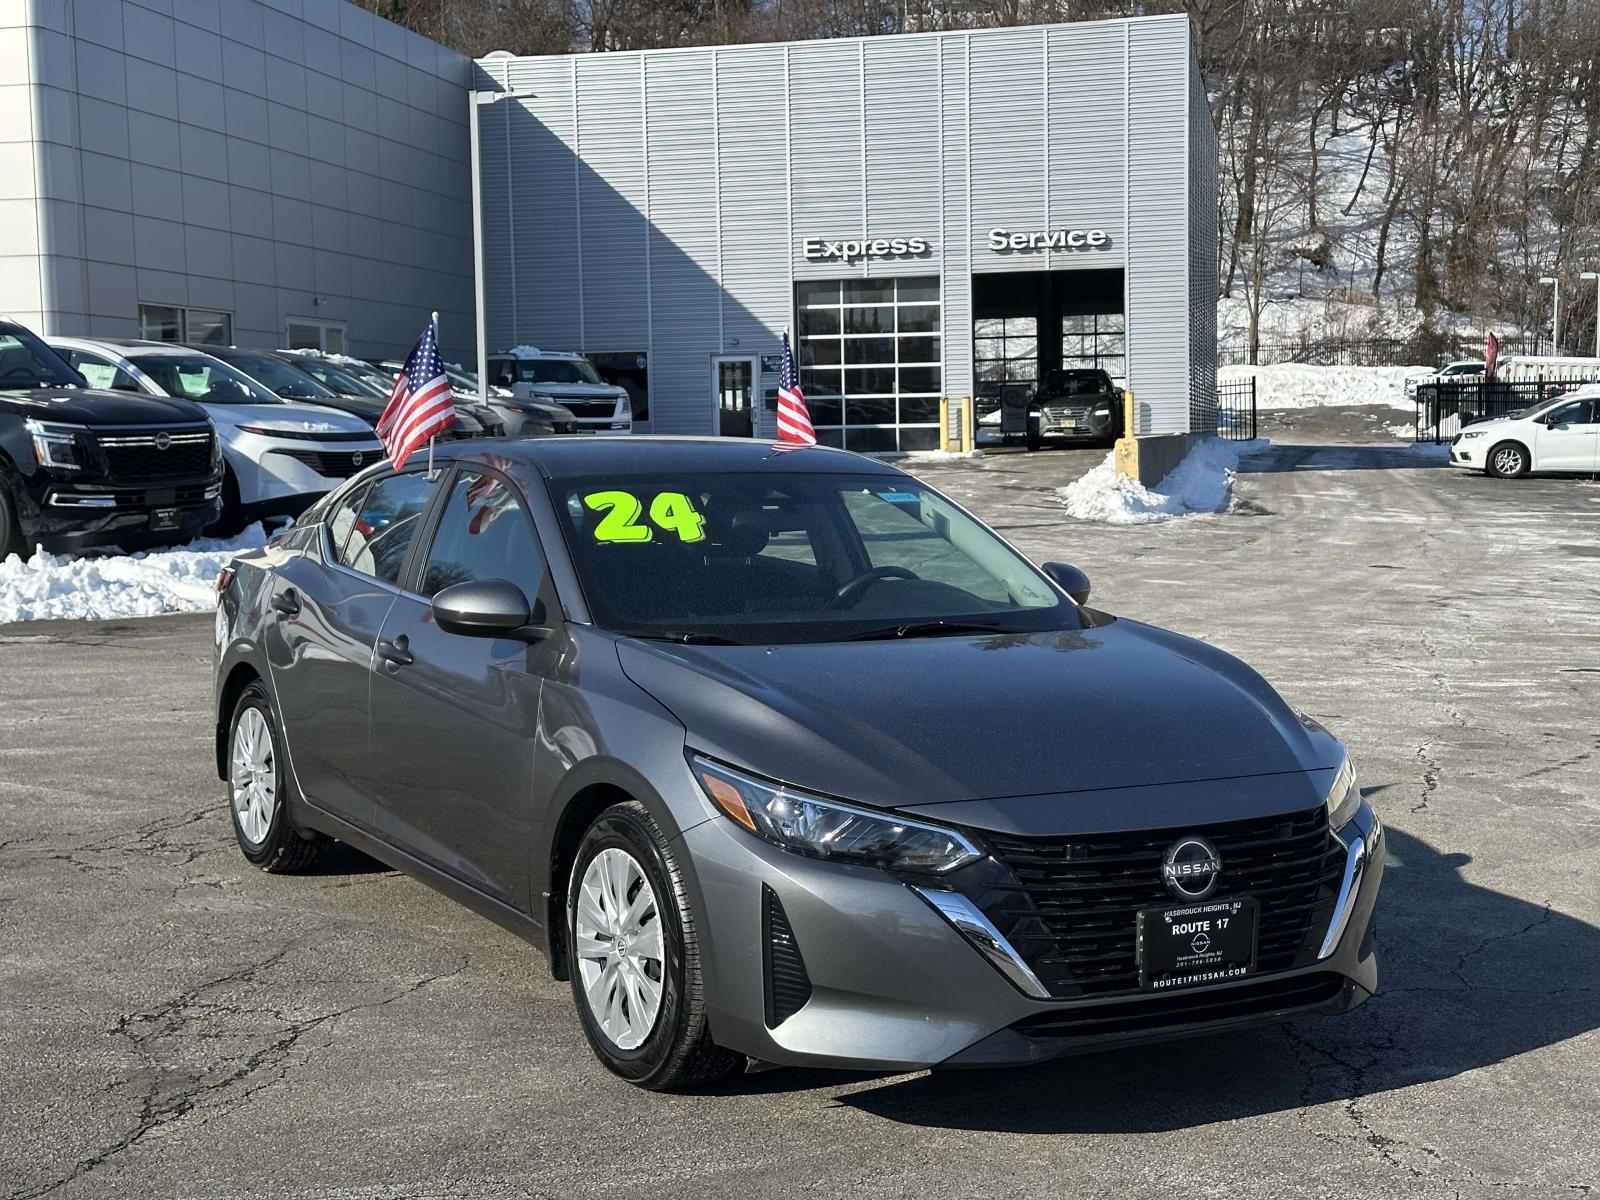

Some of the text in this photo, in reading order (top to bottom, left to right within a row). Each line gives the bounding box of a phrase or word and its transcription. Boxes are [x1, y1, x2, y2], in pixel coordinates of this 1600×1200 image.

[802, 236, 927, 261] Express
[987, 226, 1107, 250] Service
[584, 490, 707, 543] 24
[1165, 860, 1220, 876] NISSAN
[1164, 906, 1203, 918] HASBROUCK
[1172, 918, 1230, 935] ROUTE 17
[1153, 967, 1247, 989] ROUTE17NISSAN.COM
